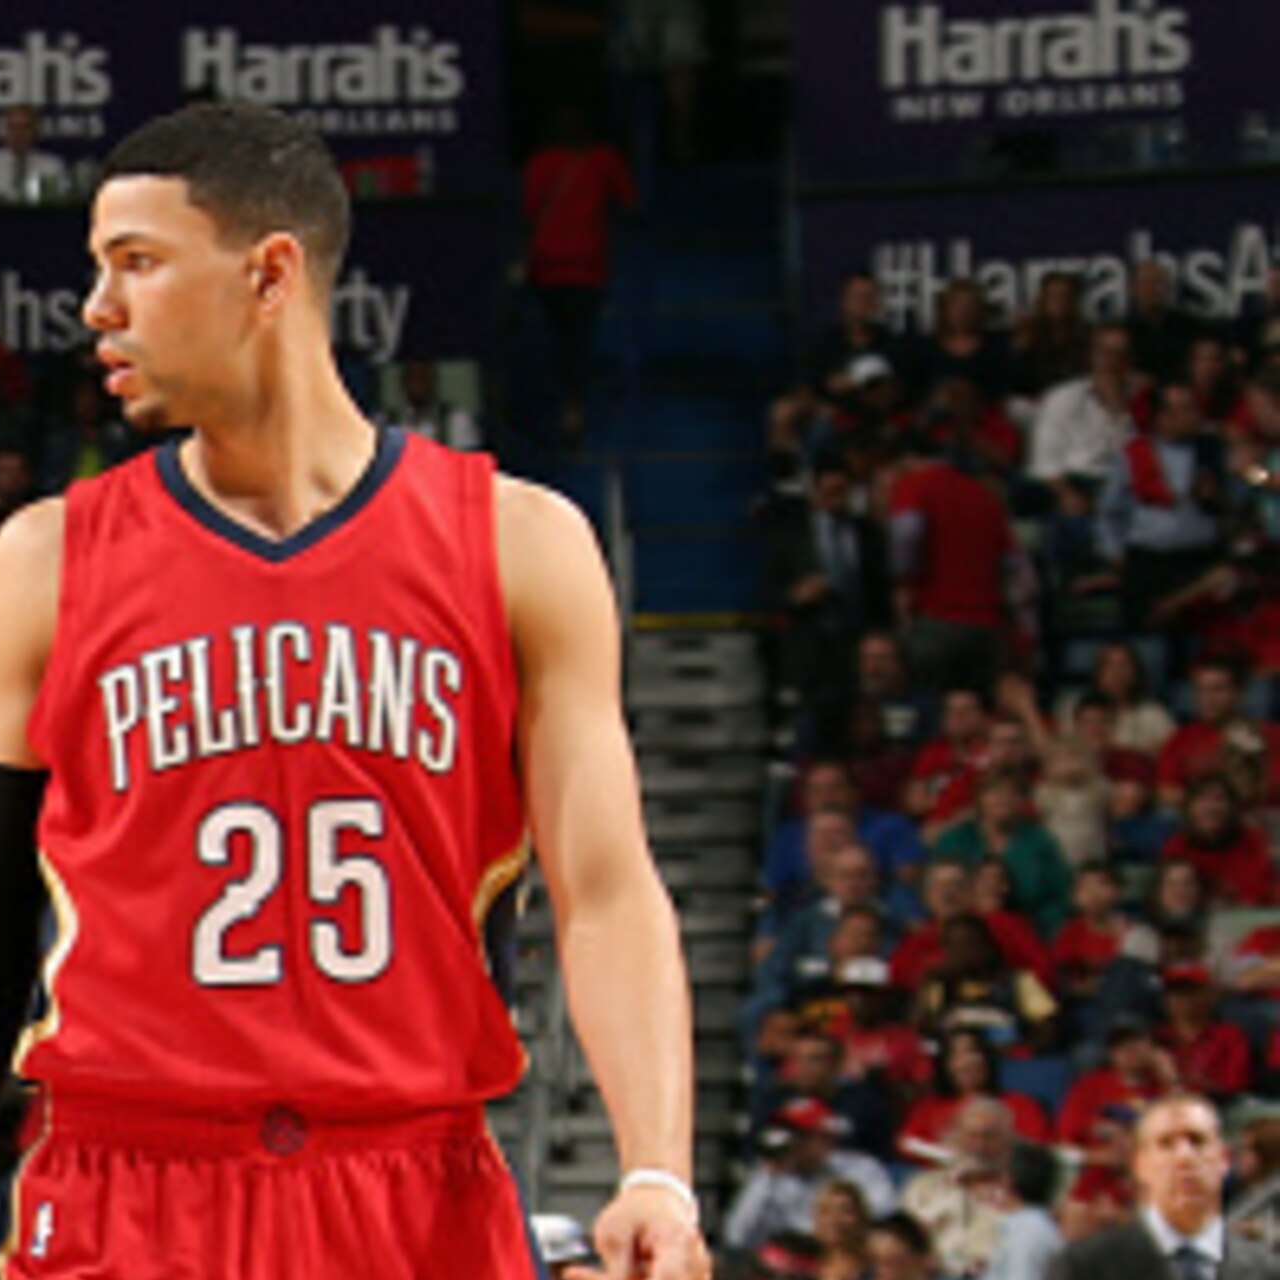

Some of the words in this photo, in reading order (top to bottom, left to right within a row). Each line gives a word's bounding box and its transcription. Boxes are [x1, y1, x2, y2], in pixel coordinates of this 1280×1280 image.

[183, 23, 463, 104] Harrah's
[880, 0, 1191, 88] Harrah's
[97, 620, 462, 793] PELICANS
[192, 798, 393, 986] 25
